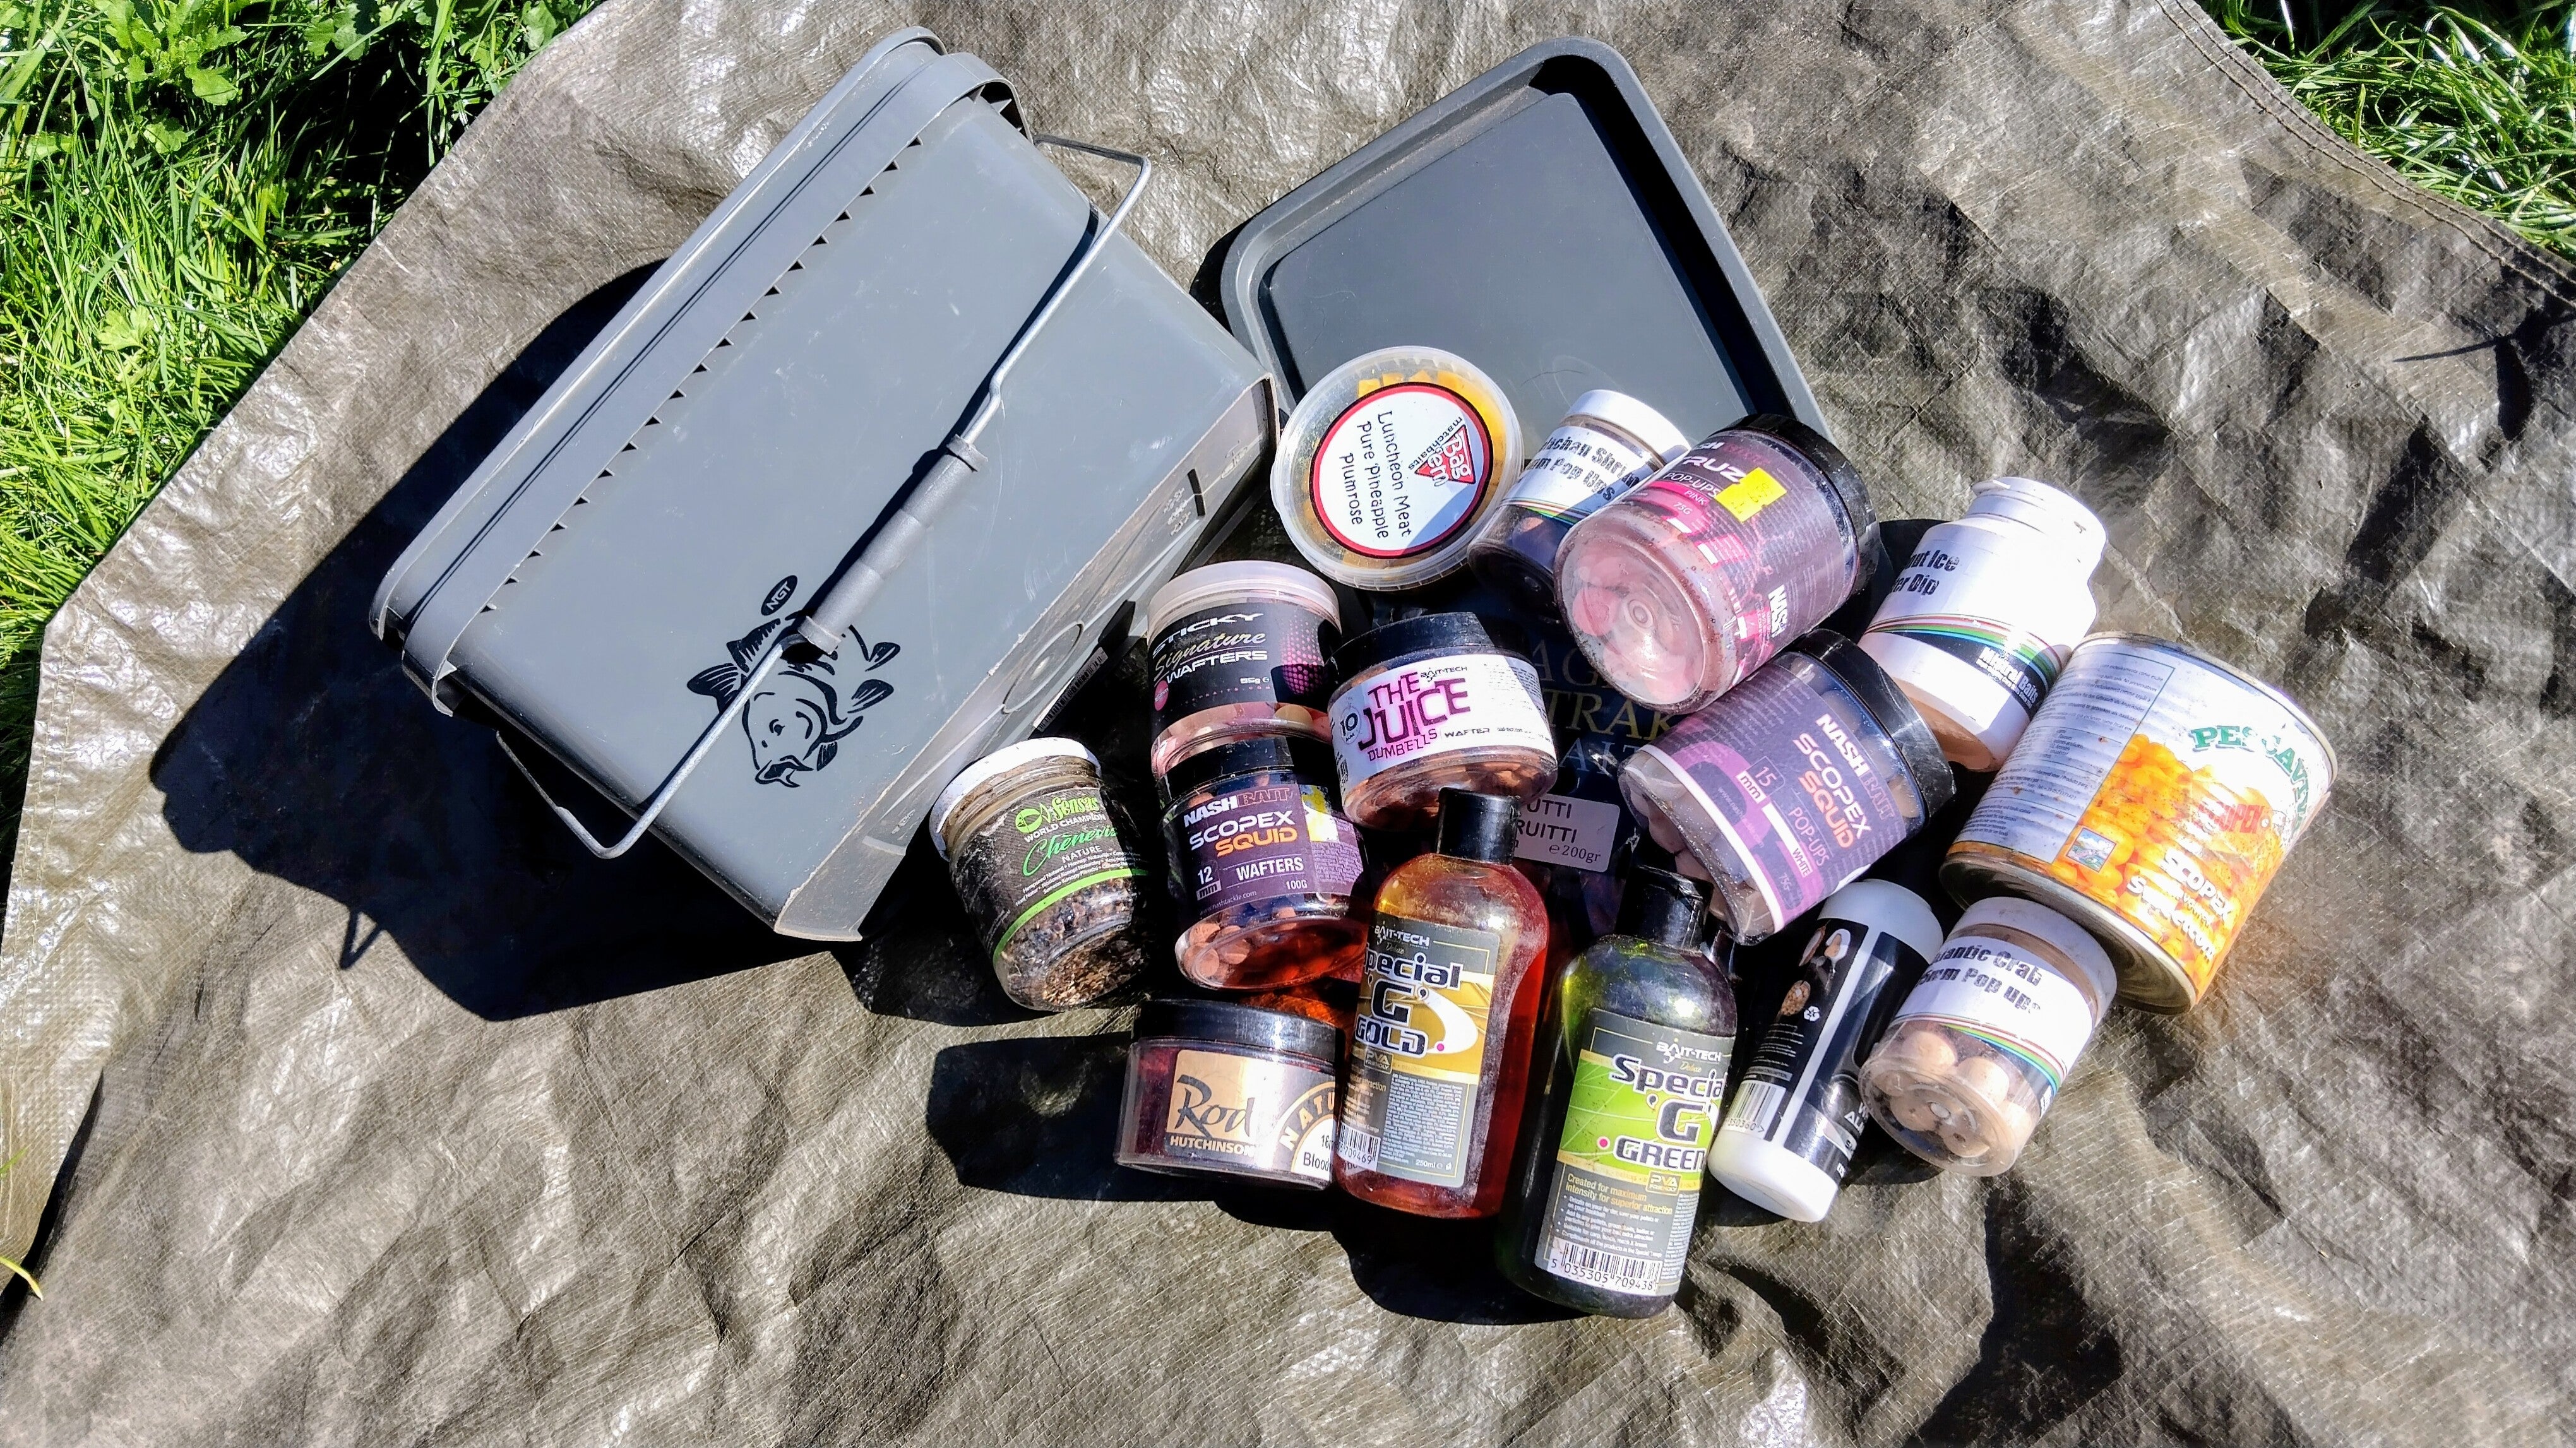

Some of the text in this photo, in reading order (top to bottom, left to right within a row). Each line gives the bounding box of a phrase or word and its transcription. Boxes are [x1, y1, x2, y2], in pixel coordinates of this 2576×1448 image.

[1408, 417, 1463, 470] matchbaits
[1443, 433, 1472, 480] Bag
[1357, 420, 1388, 538] Pure Pineapple
[1378, 410, 1412, 537] Luncheon Meat
[1683, 455, 1747, 483] RUZ
[1339, 453, 1363, 525] Plumrose
[1663, 472, 1722, 498] POP-UPS
[1684, 490, 1707, 505] PINK
[1927, 550, 1960, 571] Ice
[766, 581, 790, 610] NGT
[1907, 573, 1939, 595] Dip
[1153, 613, 1264, 658] STICKY
[1154, 631, 1266, 682] Signature
[1166, 650, 1268, 684] WAFTERS
[1421, 666, 1468, 682] BAIT-TECH
[1368, 672, 1420, 708] THE
[2020, 675, 2039, 703] Baits
[1340, 713, 1358, 736] 10
[1358, 678, 1471, 751] JUICE
[1542, 688, 1674, 740] TRAK
[1368, 729, 1438, 761] DUMBELLS
[1740, 776, 1761, 798] mm
[1755, 766, 1778, 786] 15
[1792, 732, 1872, 839] SCOPEX
[1527, 799, 1572, 819] UTTI
[1798, 769, 1855, 849] SQUID
[1024, 812, 1107, 843] WORLD CHAMPION
[1190, 810, 1296, 851] SCOPEX
[1215, 826, 1298, 857] SQUID
[1515, 819, 1577, 843] RUITTI
[1788, 807, 1830, 866] POP-UPS
[1061, 846, 1102, 863] NATURE
[1792, 848, 1811, 876] WHITE
[1197, 865, 1213, 886] 12
[1236, 857, 1304, 882] WAFTERS
[1200, 884, 1217, 898] mm
[1285, 879, 1308, 890] 100G
[1374, 924, 1430, 947] BAIT-TECH
[1364, 952, 1464, 991] pecial
[1961, 968, 2003, 994] Pop
[1993, 951, 2042, 987] Crab
[1355, 1017, 1428, 1058] GOLD
[1367, 1050, 1390, 1065] PVA
[1656, 1040, 1722, 1064] BAIT-TECH
[1609, 1054, 1728, 1099] Specia
[1174, 1074, 1255, 1139] Rod
[1279, 1091, 1335, 1152] NATU
[1170, 1136, 1256, 1158] HUTCHINSON
[1345, 1146, 1373, 1165] 709469
[1303, 1152, 1332, 1172] Blood
[1416, 1159, 1436, 1168] 250ml
[1568, 1173, 1647, 1201] Created for maximum
[1650, 1175, 1678, 1187] PVA
[1566, 1184, 1673, 1215] intensity for superior attraction
[1551, 1259, 1653, 1291] 5 035305 709438
